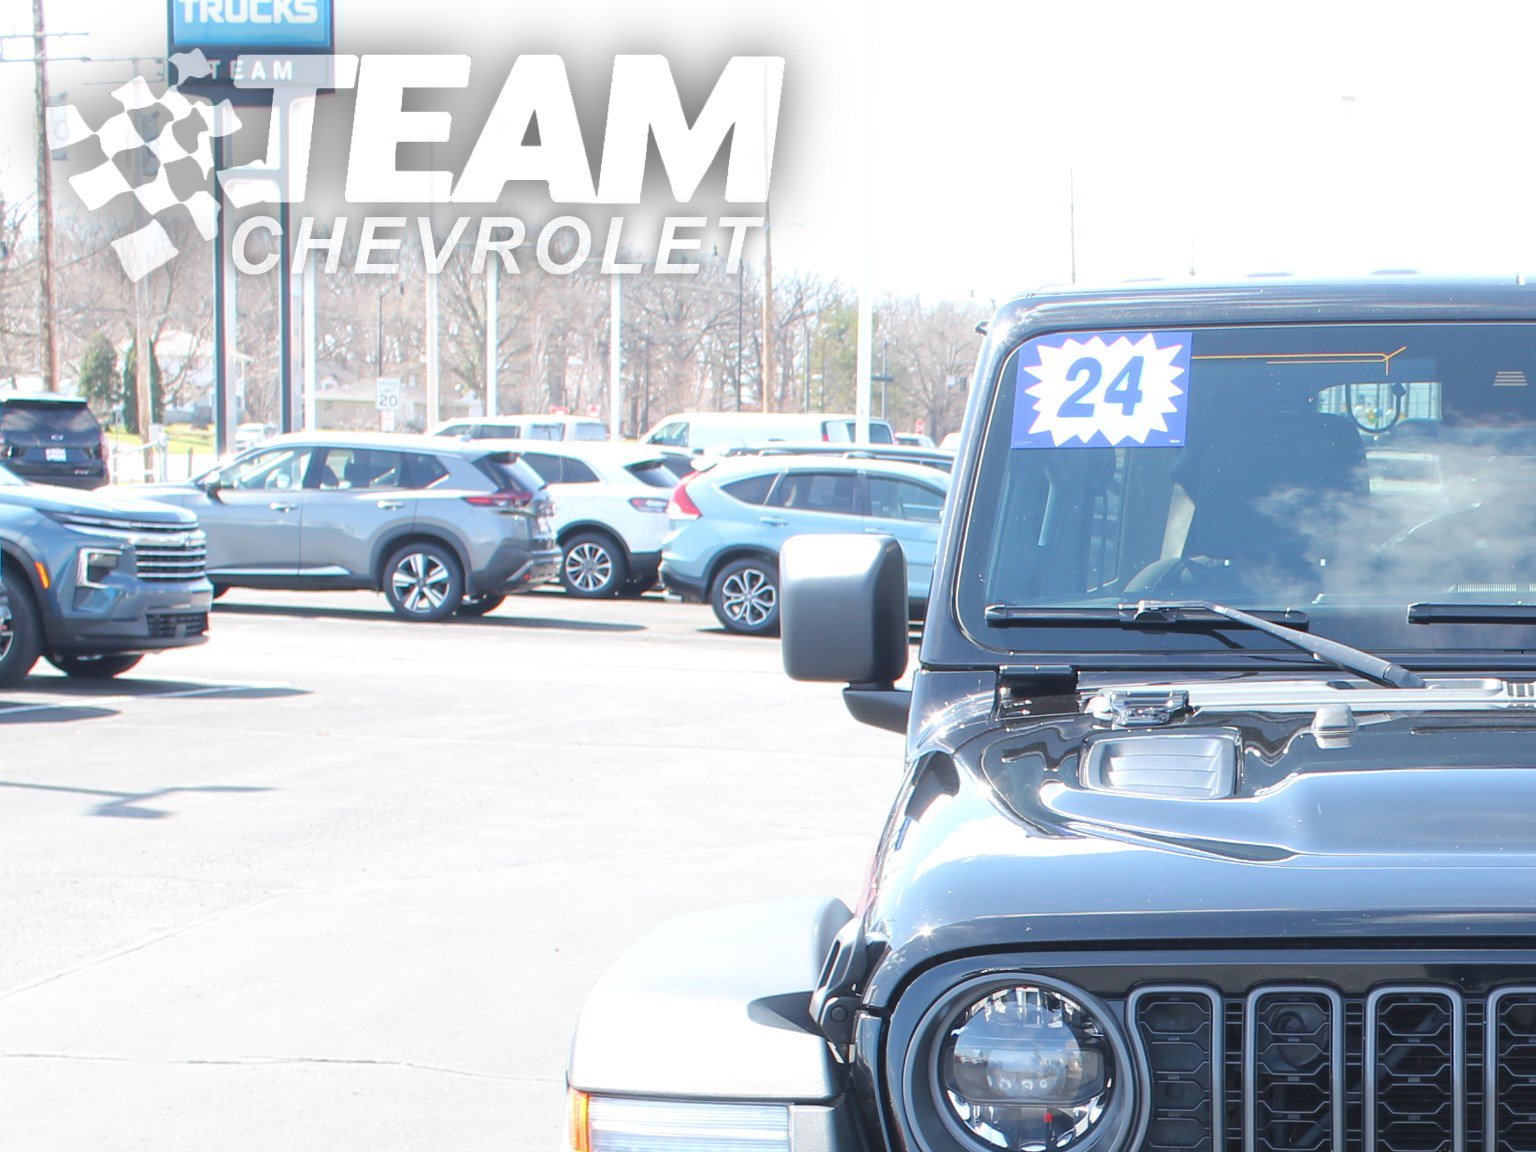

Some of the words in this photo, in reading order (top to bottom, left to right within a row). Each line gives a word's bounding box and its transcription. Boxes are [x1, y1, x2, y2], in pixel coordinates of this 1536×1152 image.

[178, 0, 318, 24] TRUCKS
[207, 59, 293, 80] TEAM
[1056, 355, 1144, 418] 24
[379, 394, 398, 407] 20
